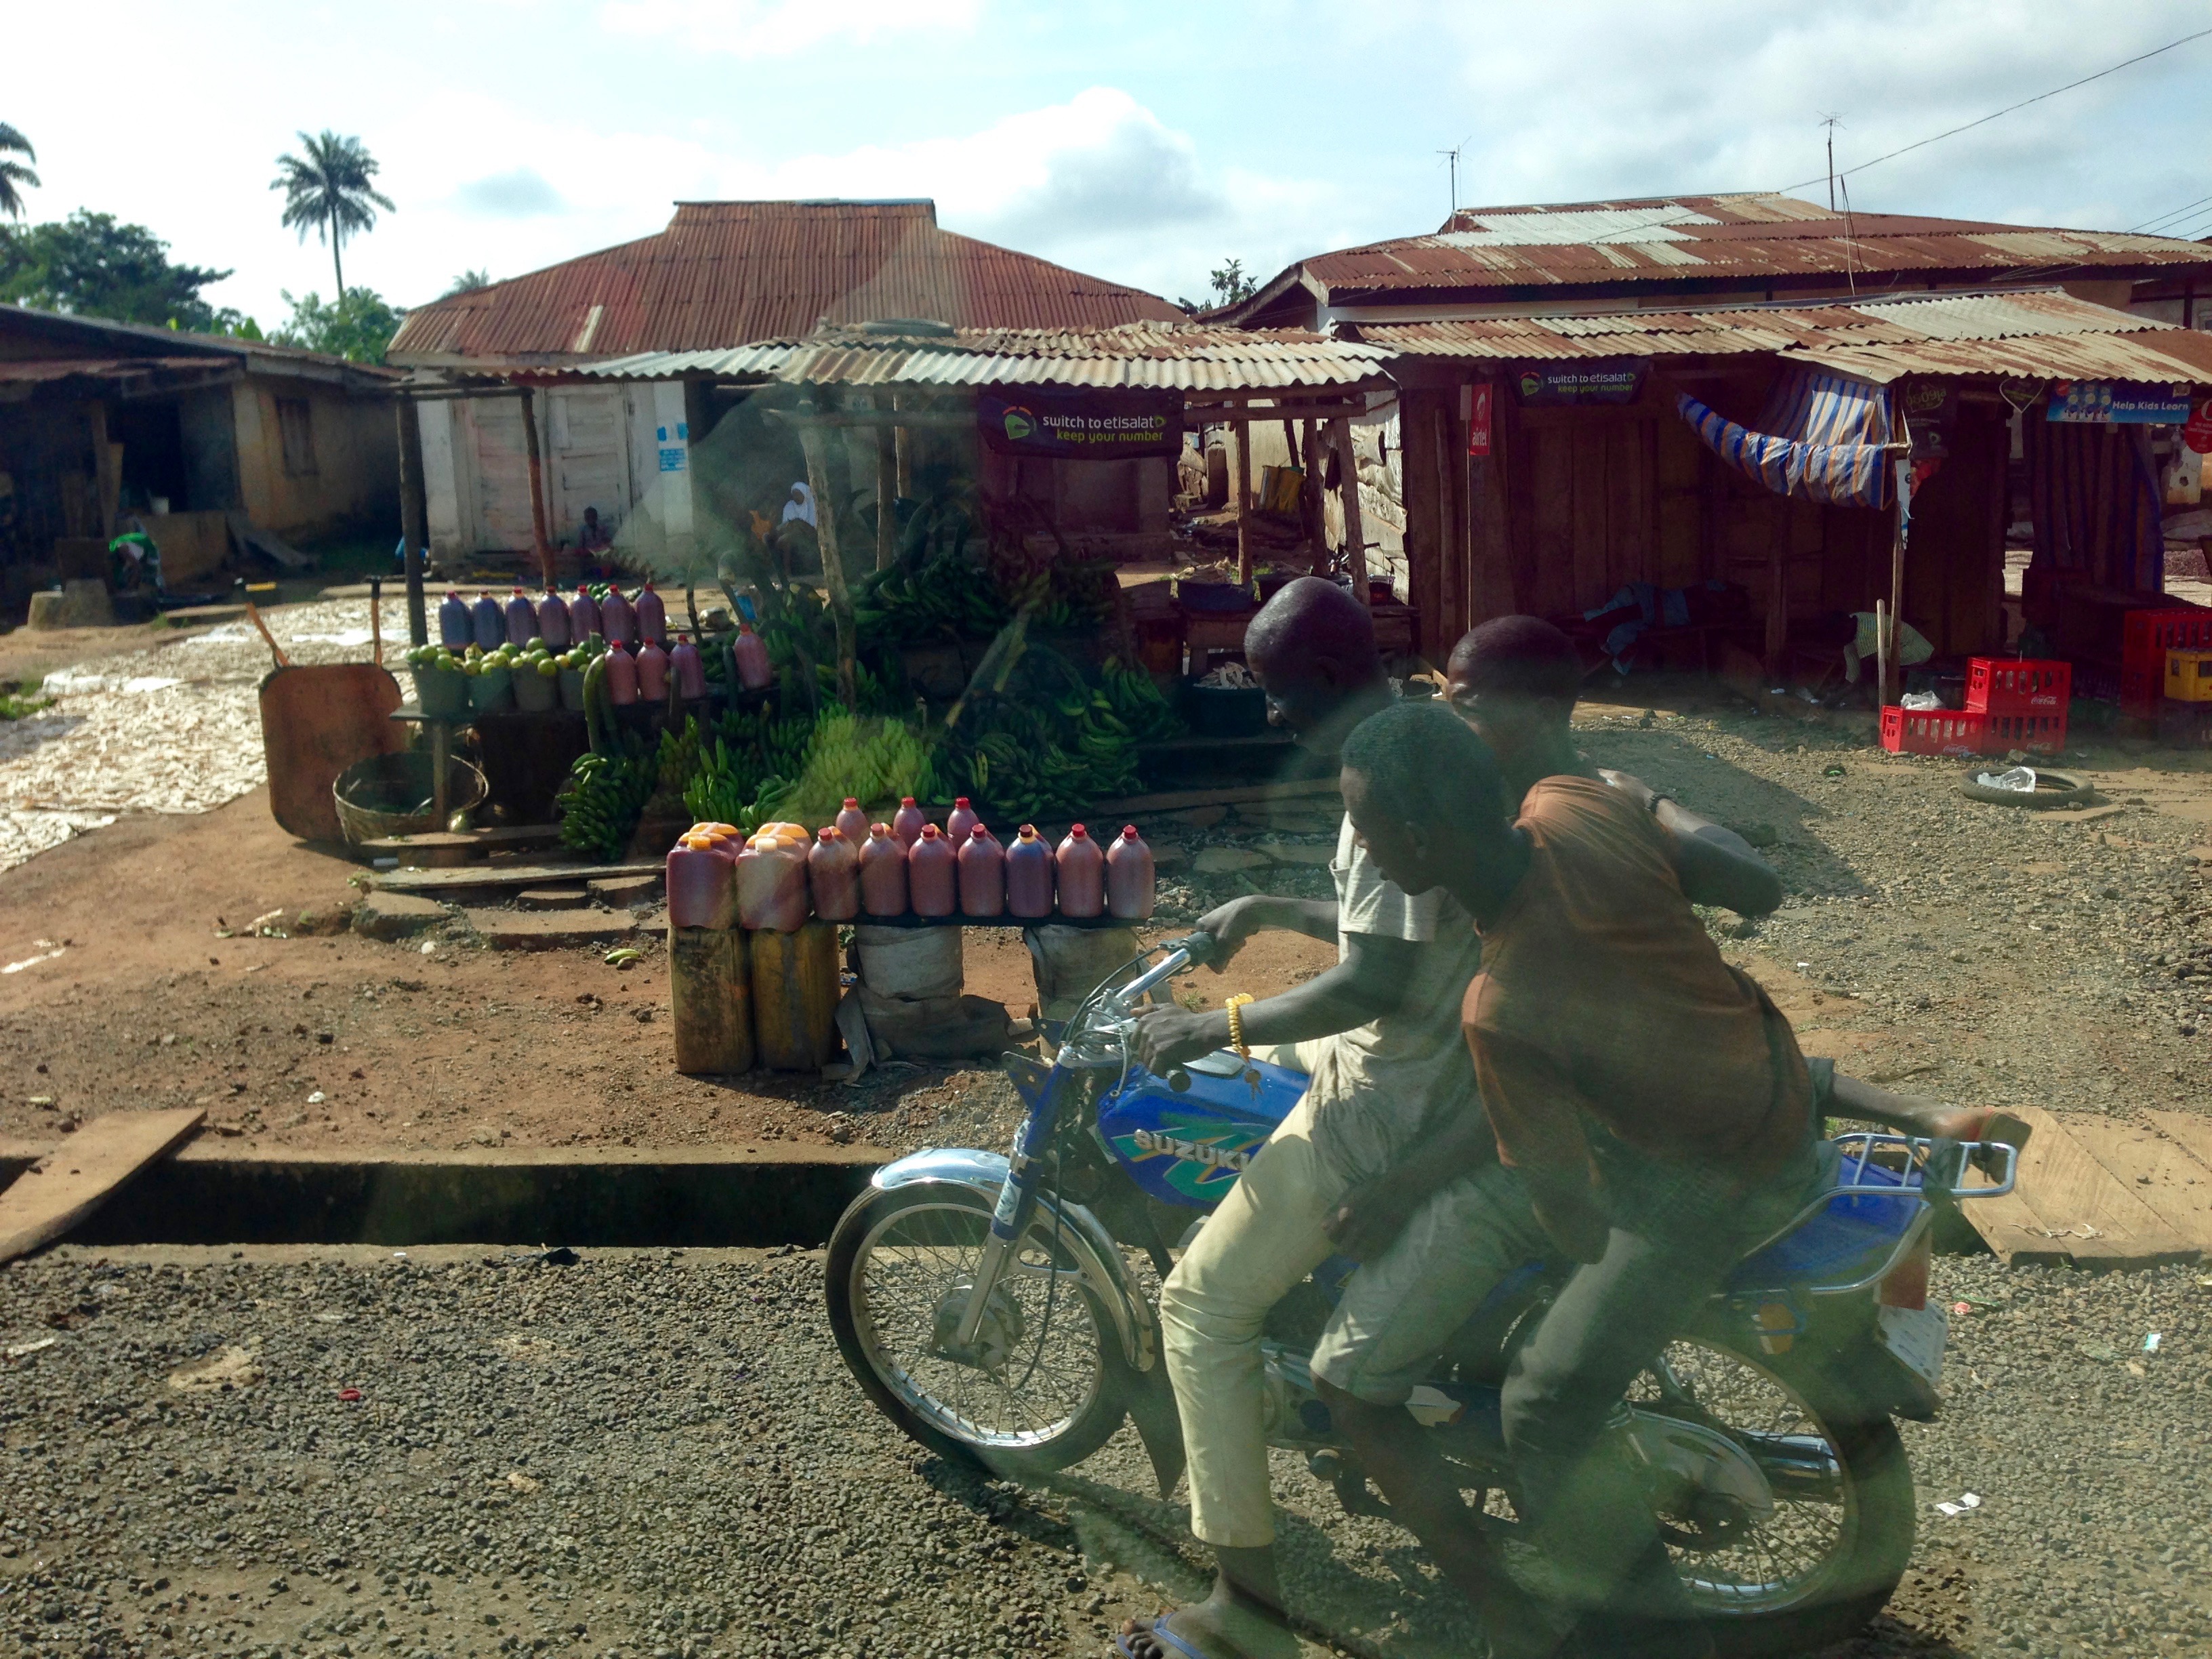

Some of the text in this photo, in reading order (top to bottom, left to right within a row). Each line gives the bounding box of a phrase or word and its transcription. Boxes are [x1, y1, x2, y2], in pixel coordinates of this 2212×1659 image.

[1547, 373, 1626, 384] switch to etisalat
[1557, 382, 1633, 394] keep your number
[2112, 401, 2189, 411] Help Kids Learn
[1042, 415, 1154, 429] switch to etisalat
[1057, 429, 1164, 443] keep your number
[1472, 427, 1488, 447] airtel
[1133, 1128, 1250, 1171] SUZUKI
